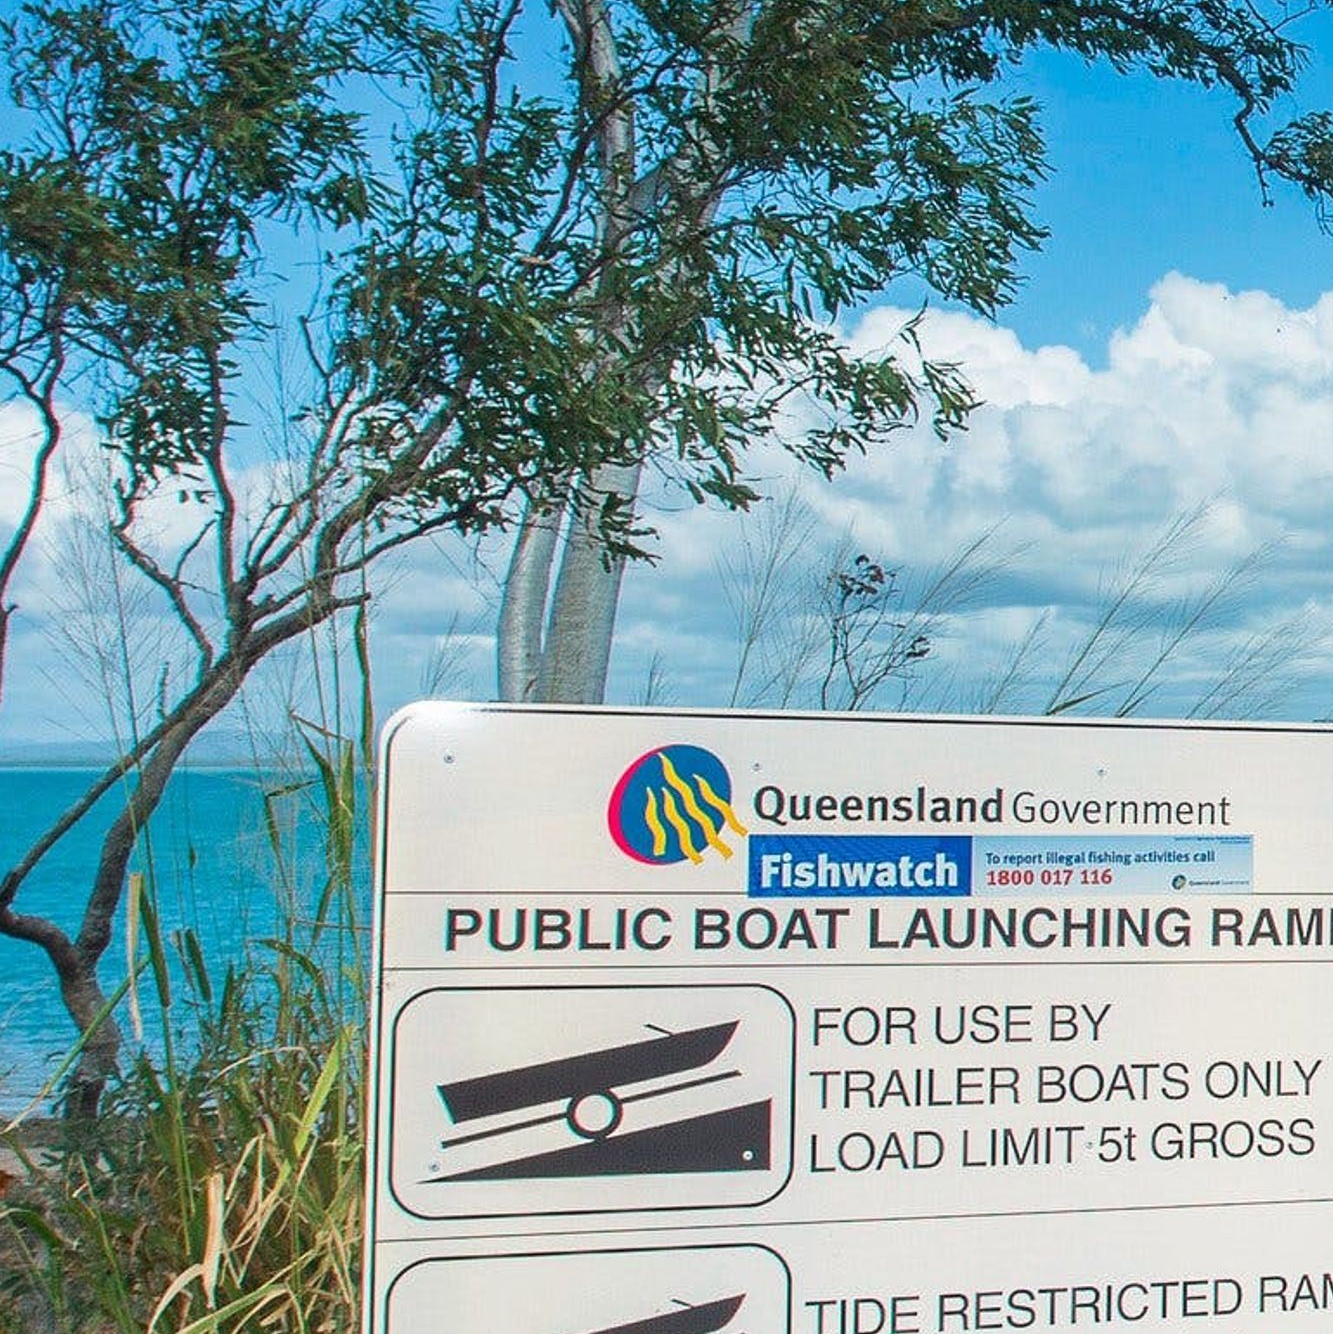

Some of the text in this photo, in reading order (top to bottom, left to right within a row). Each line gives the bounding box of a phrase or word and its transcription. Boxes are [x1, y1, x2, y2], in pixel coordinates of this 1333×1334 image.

[754, 786, 1229, 826] Queensland Government
[760, 853, 958, 887] Fishwatch
[986, 850, 1215, 866] To report illegal fishing activities call
[987, 868, 1112, 885] 1800 017 116
[445, 908, 671, 951] PUBLIC
[694, 907, 850, 950] BOAT
[870, 908, 1190, 948] LAUNCHING
[813, 1004, 1111, 1046] FOR USE BY
[810, 1060, 1321, 1108] TRAILER BOATS ONLY
[811, 1119, 1314, 1172] LOAD LIMIT 5t GROSS
[939, 1279, 1242, 1331] RESTRICTED
